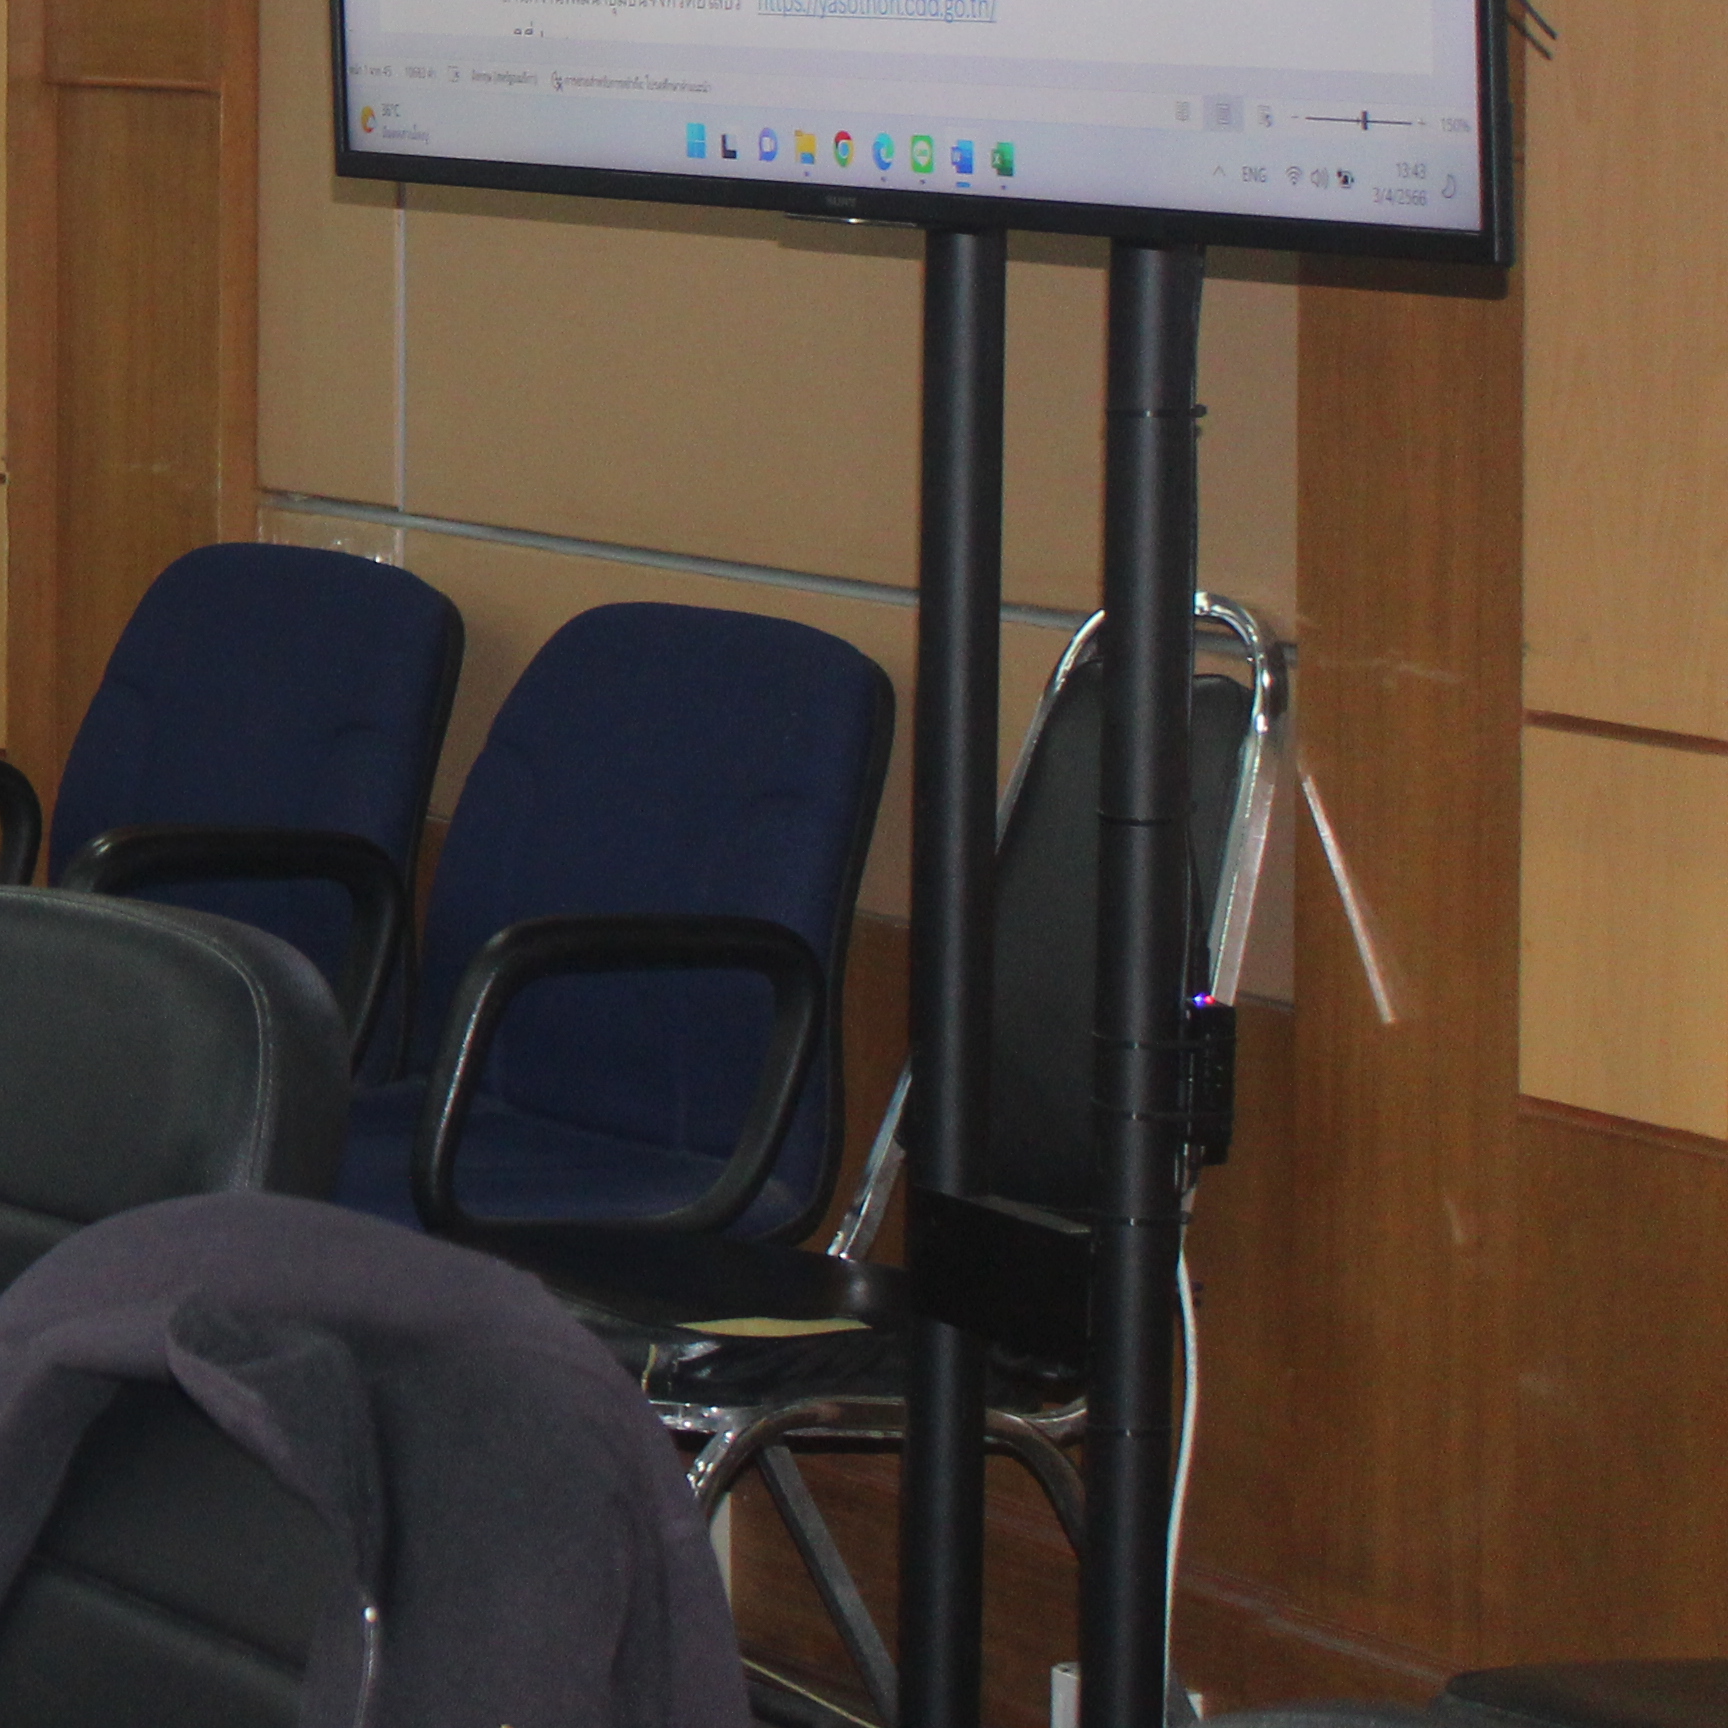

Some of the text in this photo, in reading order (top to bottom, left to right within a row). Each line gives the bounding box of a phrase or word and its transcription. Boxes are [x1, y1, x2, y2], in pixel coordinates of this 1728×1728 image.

[1240, 164, 1268, 185] ENG
[1394, 159, 1428, 181] 13:43
[1371, 186, 1429, 208] 3/4/2566
